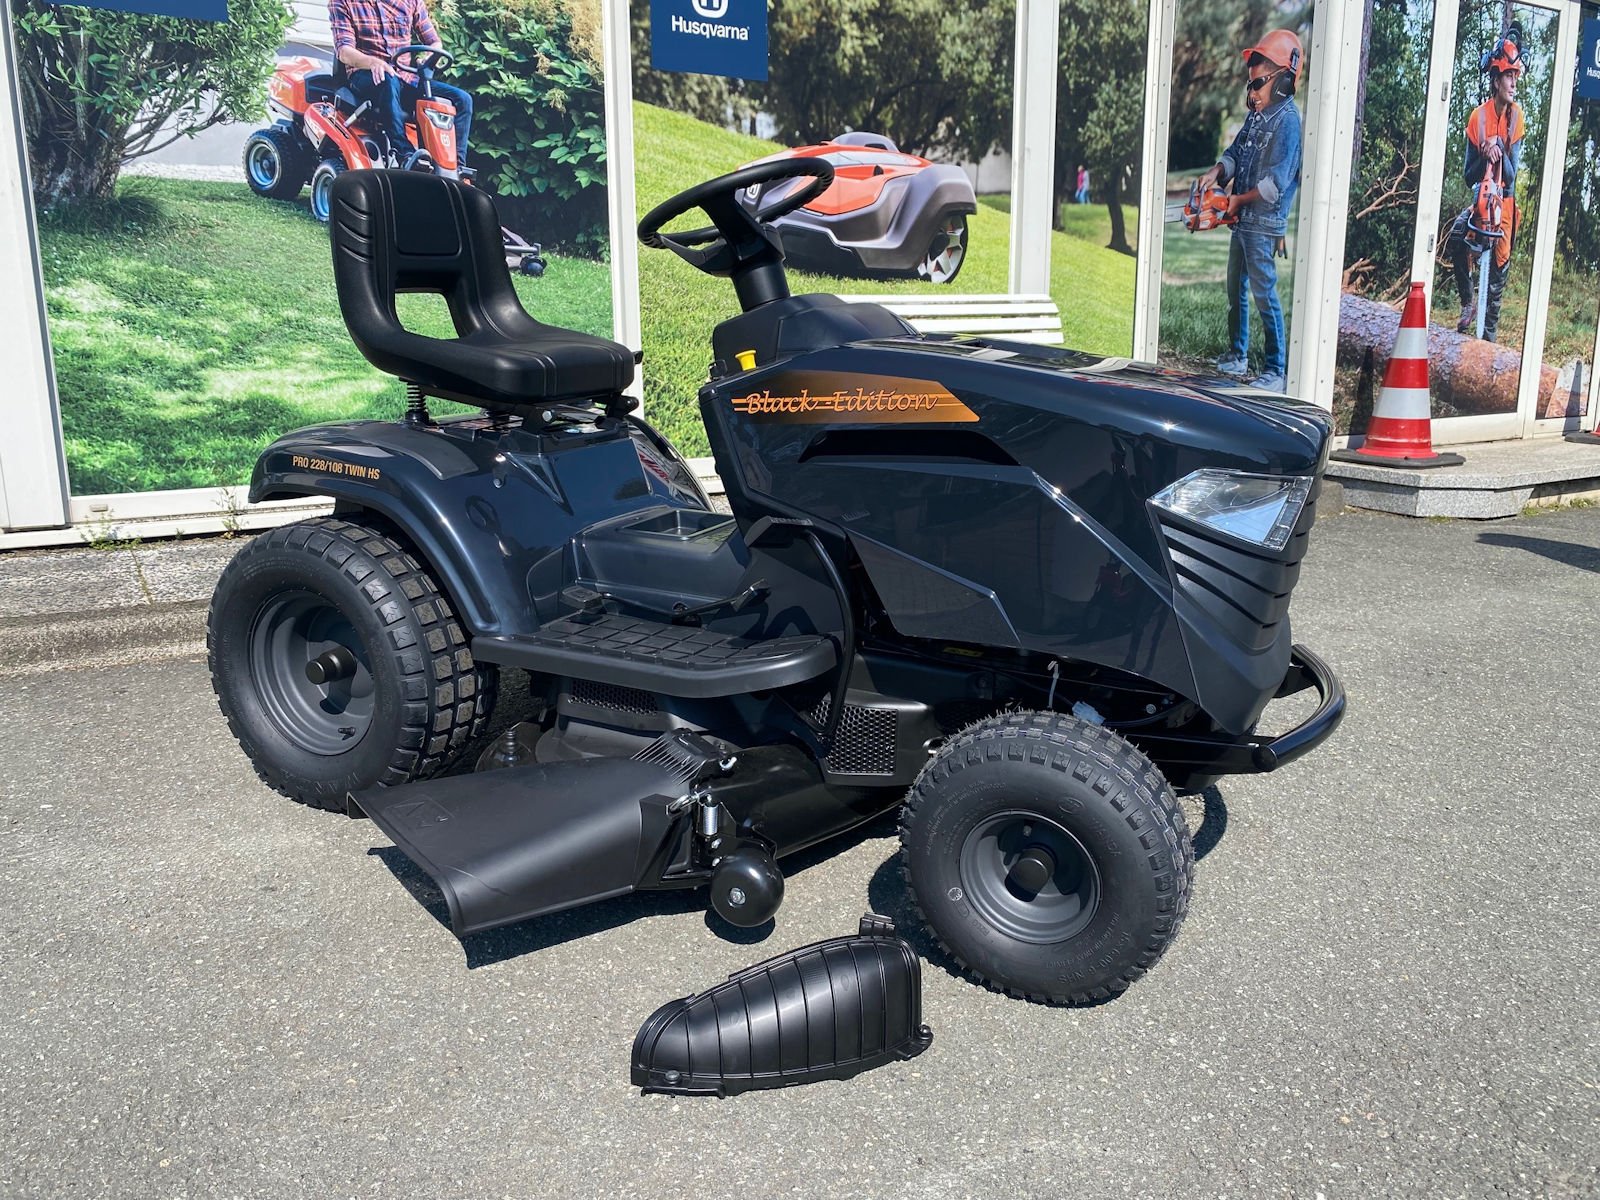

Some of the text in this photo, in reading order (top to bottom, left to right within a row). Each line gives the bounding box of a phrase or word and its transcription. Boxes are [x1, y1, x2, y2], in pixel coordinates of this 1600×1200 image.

[671, 15, 749, 40] Husqvarna
[746, 389, 818, 414] Black
[292, 455, 380, 480] PRO 228/108 TWIN HS
